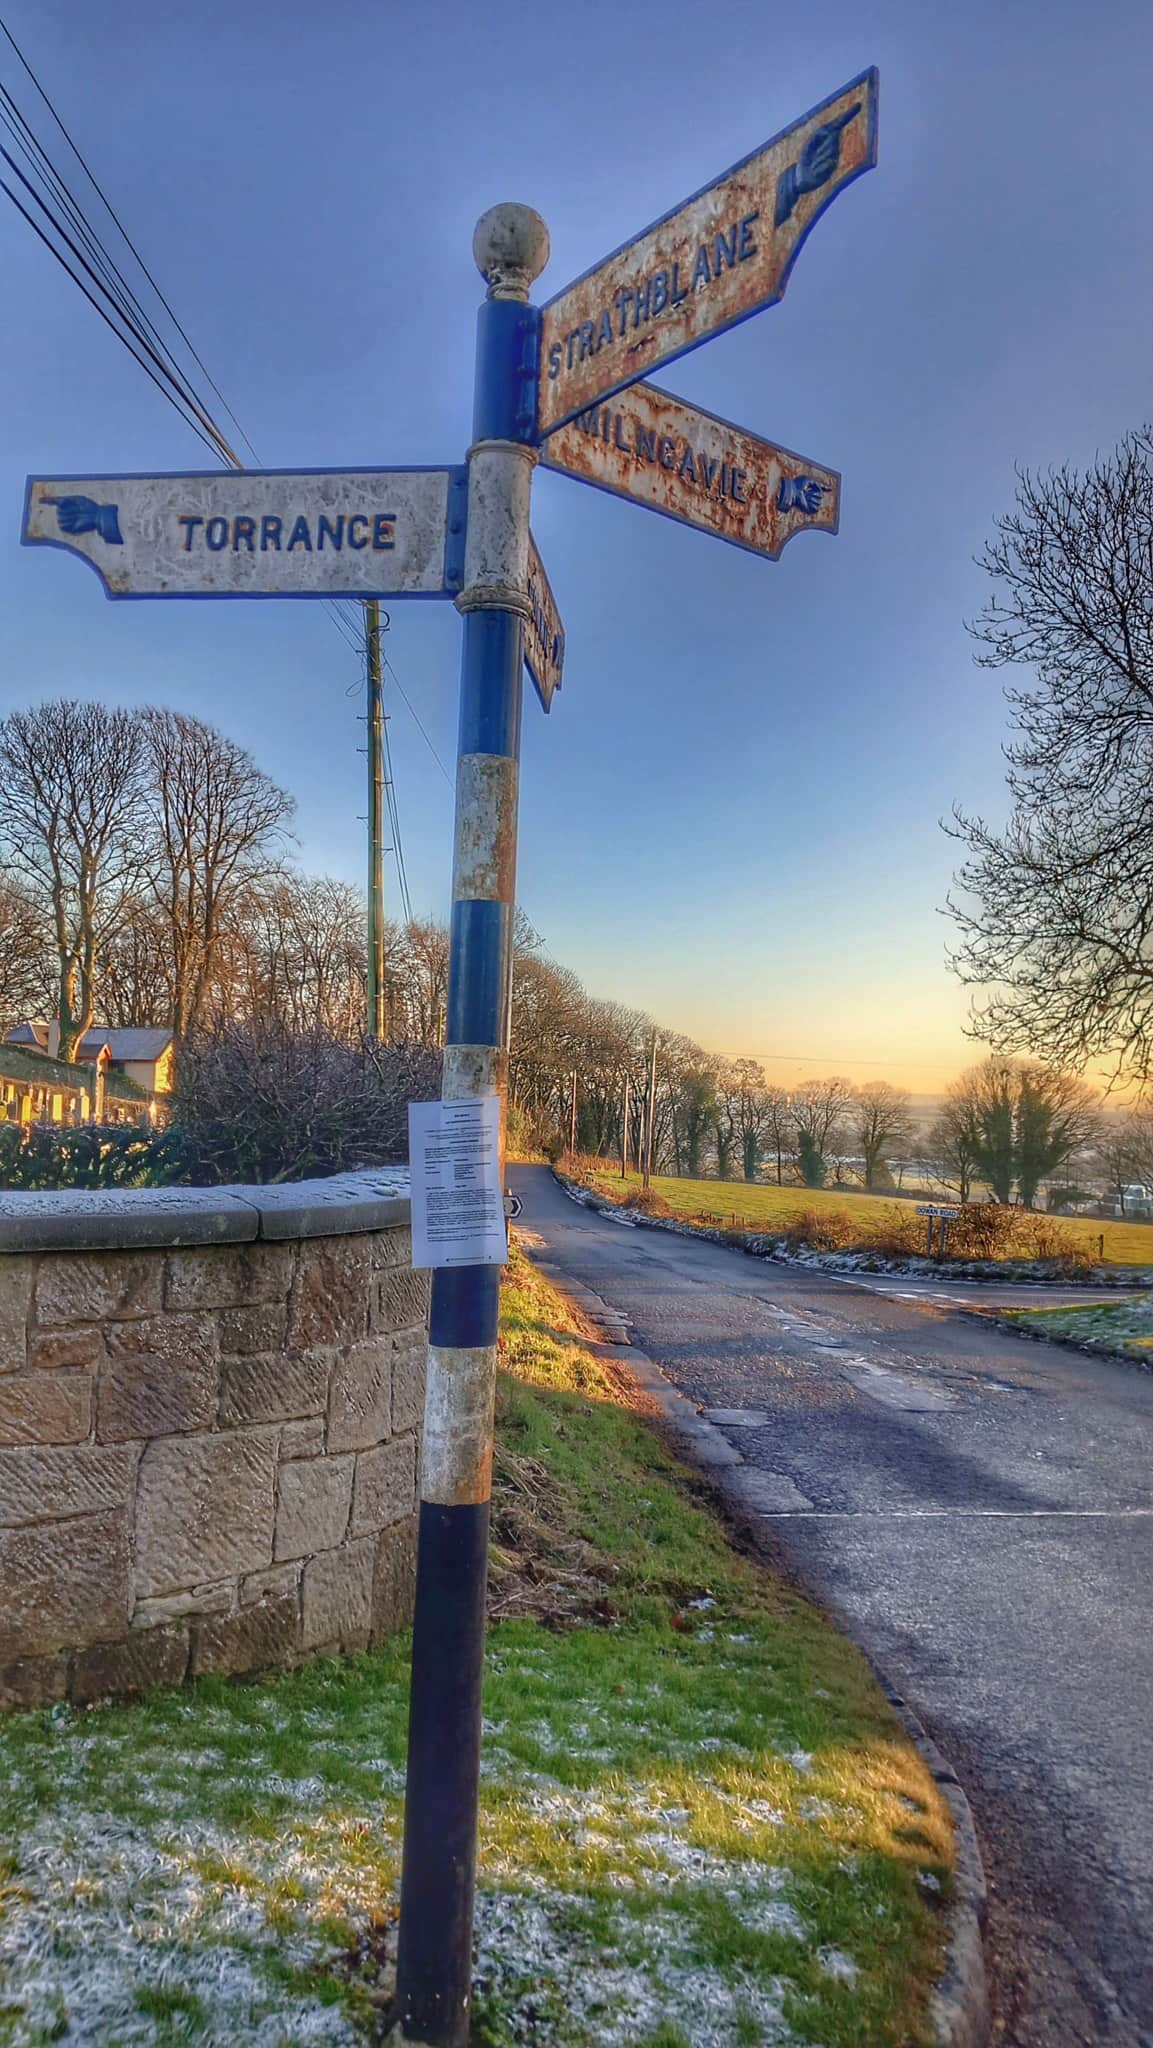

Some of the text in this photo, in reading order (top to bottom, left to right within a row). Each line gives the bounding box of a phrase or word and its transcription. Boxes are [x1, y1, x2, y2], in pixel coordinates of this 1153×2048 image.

[547, 210, 759, 380] STRATHBLANE
[574, 406, 748, 504] MILNGAVIE
[178, 513, 397, 552] TORRANCE
[940, 1209, 956, 1217] ROAD
